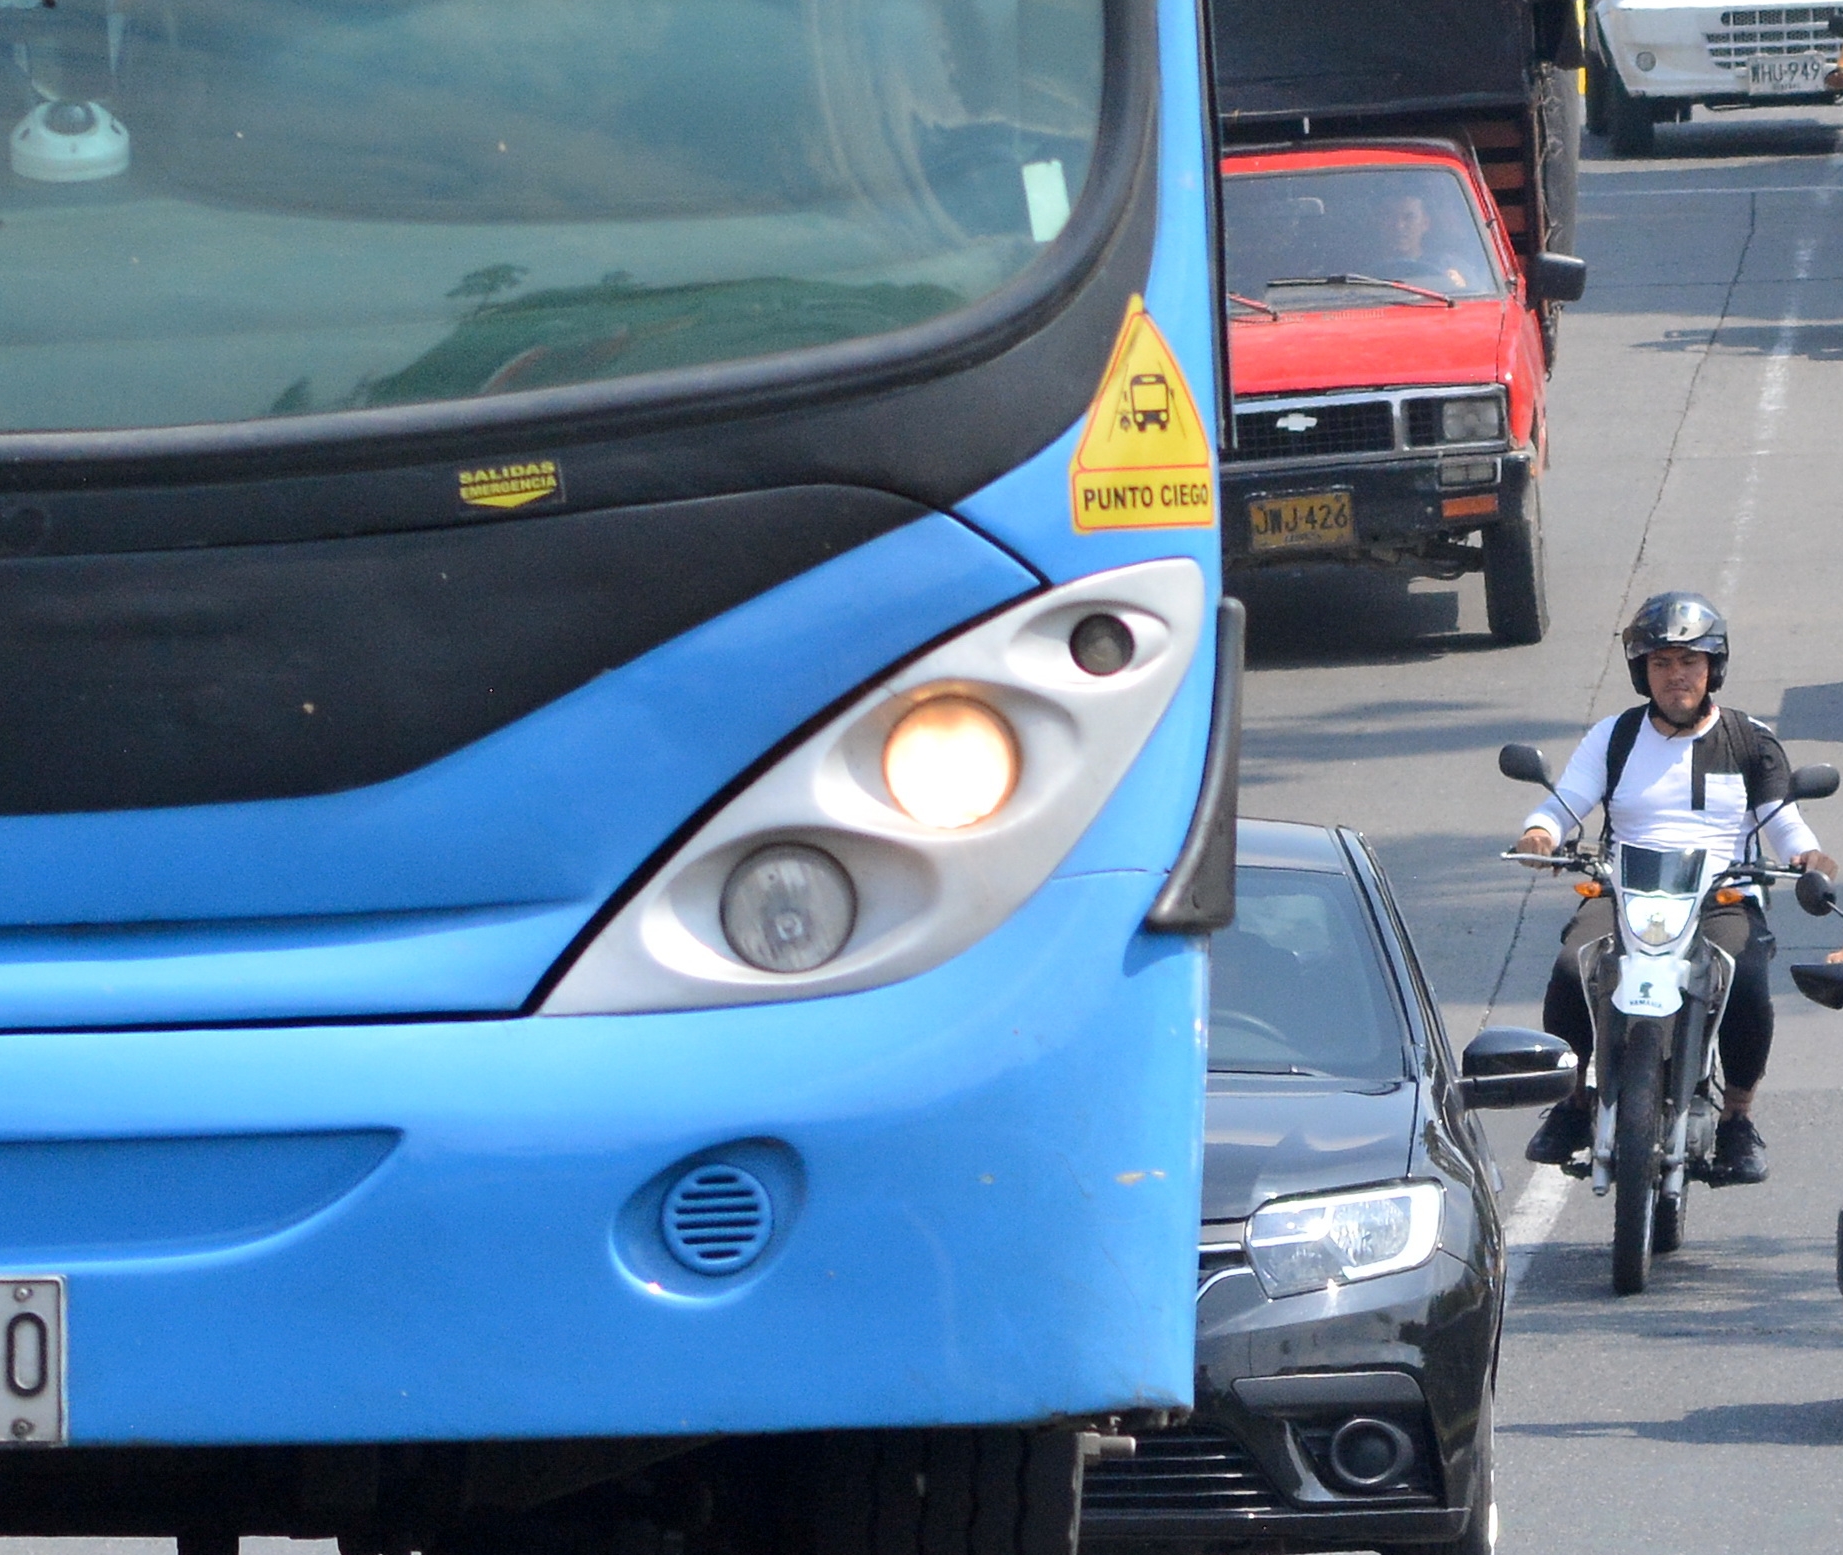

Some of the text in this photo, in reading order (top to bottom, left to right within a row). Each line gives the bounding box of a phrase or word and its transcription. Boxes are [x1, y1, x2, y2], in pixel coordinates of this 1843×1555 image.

[459, 461, 556, 485] SALIDAS
[460, 475, 557, 501] EMERGENCIA
[1083, 483, 1209, 512] PUNTO CIEGO
